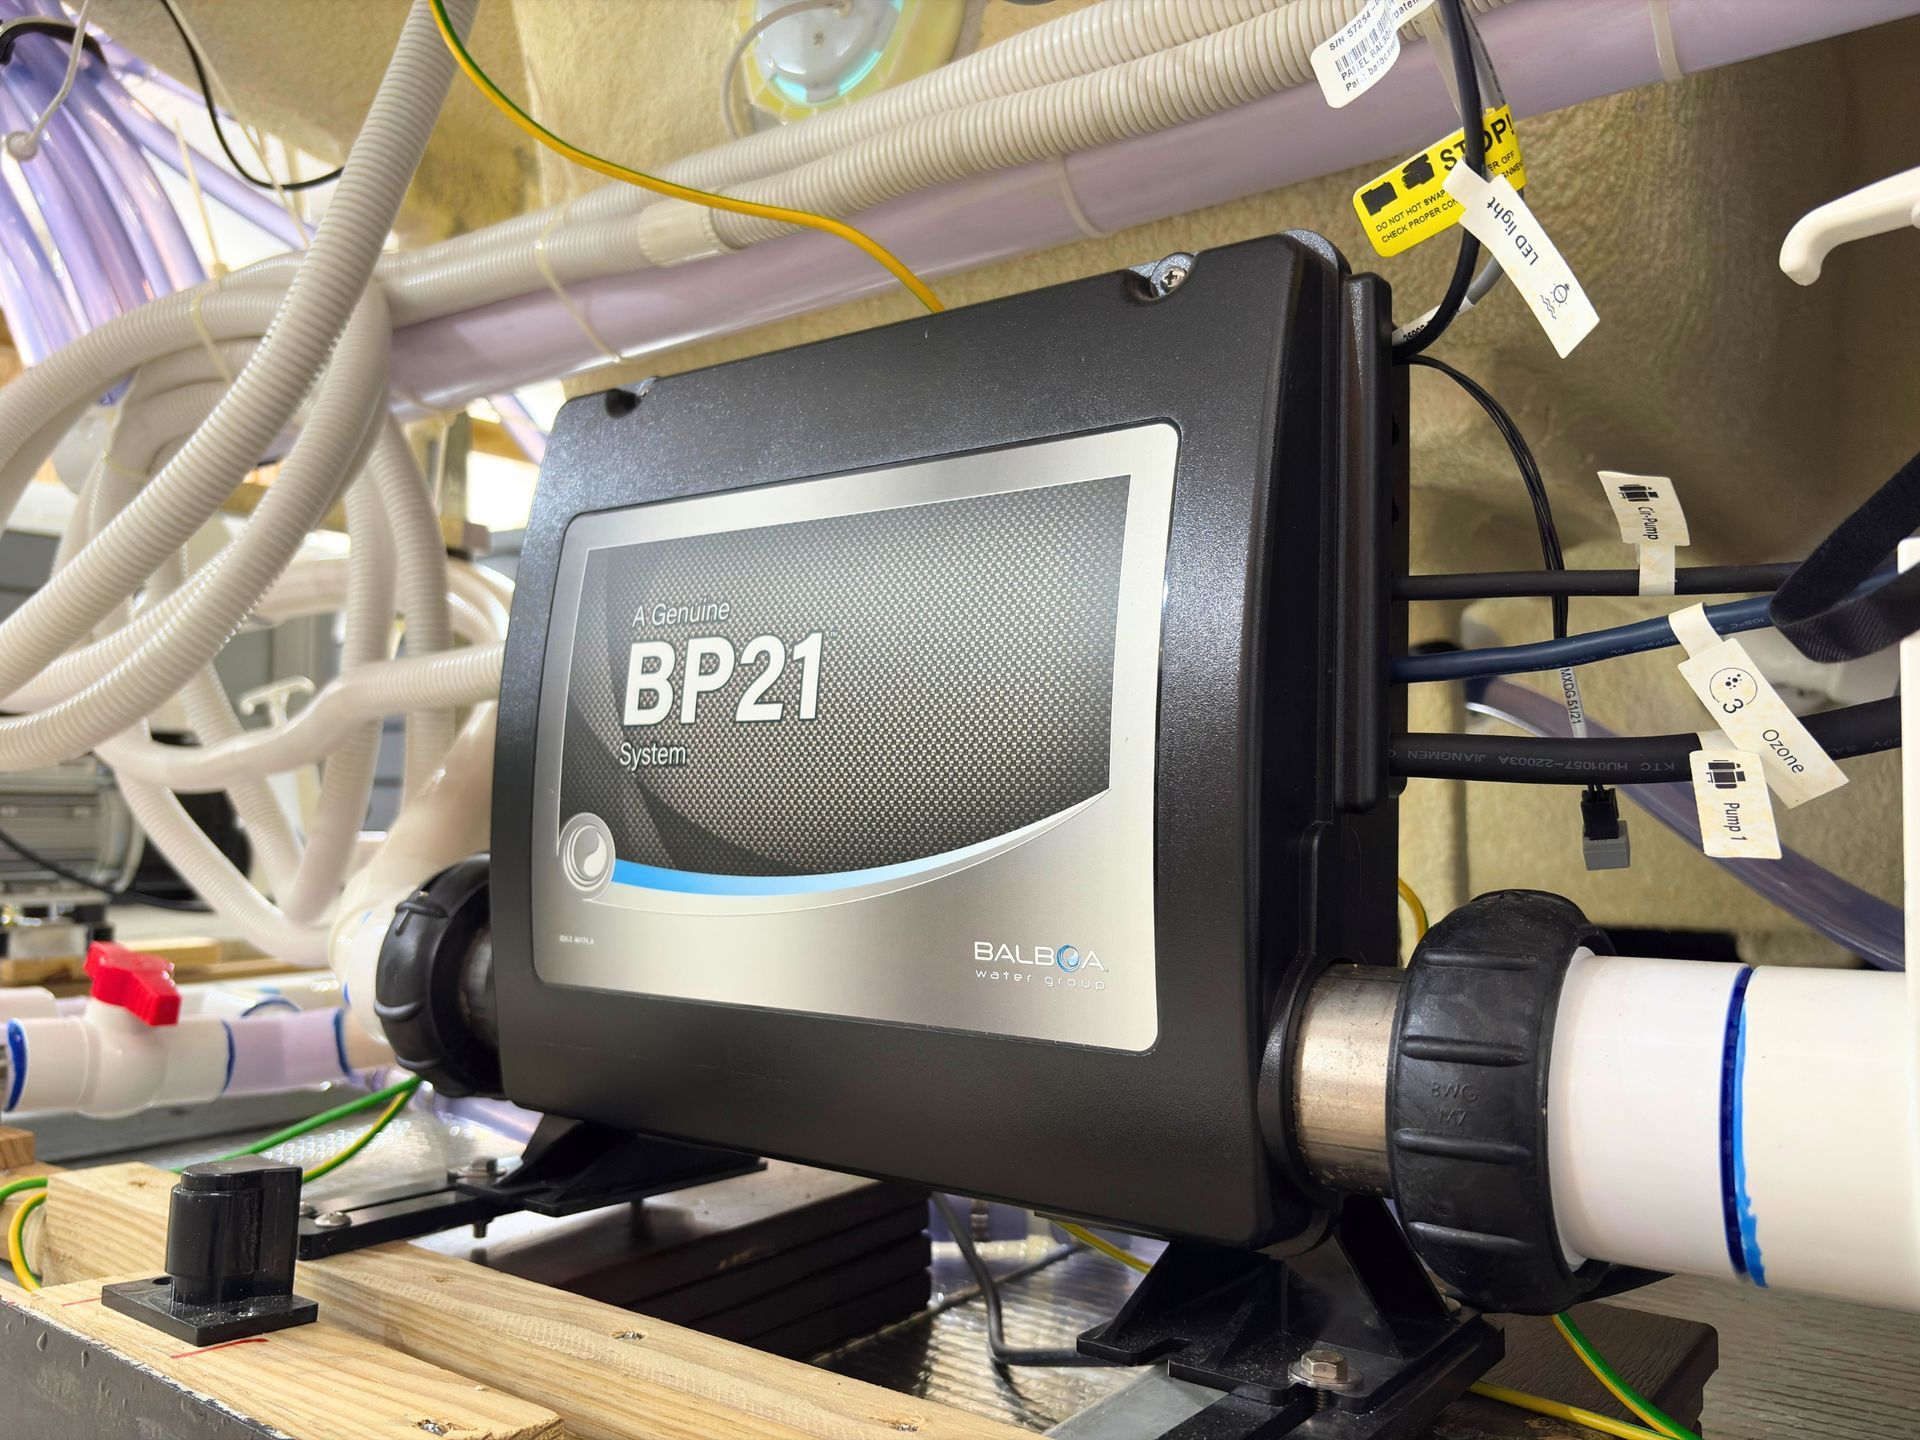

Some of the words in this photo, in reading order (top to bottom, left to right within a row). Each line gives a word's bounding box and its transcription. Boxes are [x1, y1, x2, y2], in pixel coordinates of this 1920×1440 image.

[1329, 35, 1345, 51] S/N
[1375, 221, 1388, 233] DO
[1389, 211, 1405, 226] NOT
[1406, 202, 1422, 217] HOT
[1423, 189, 1446, 206] SWAP
[1500, 151, 1515, 165] OFF
[1381, 226, 1408, 243] CHECK
[1408, 207, 1441, 230] PROPER
[1442, 198, 1459, 212] CON
[1486, 196, 1518, 236] light
[1515, 234, 1539, 266] LED
[632, 605, 645, 627] A
[652, 598, 730, 625] Genuine
[624, 632, 822, 726] BP21
[620, 741, 687, 771] System
[1407, 750, 1486, 763] JIANGMEN
[1640, 762, 1675, 771] KTC
[1762, 729, 1805, 774] Ozone
[1724, 802, 1741, 832] Pump
[974, 941, 1105, 972] BALBOA
[975, 969, 1032, 982] water
[1044, 976, 1105, 991] group
